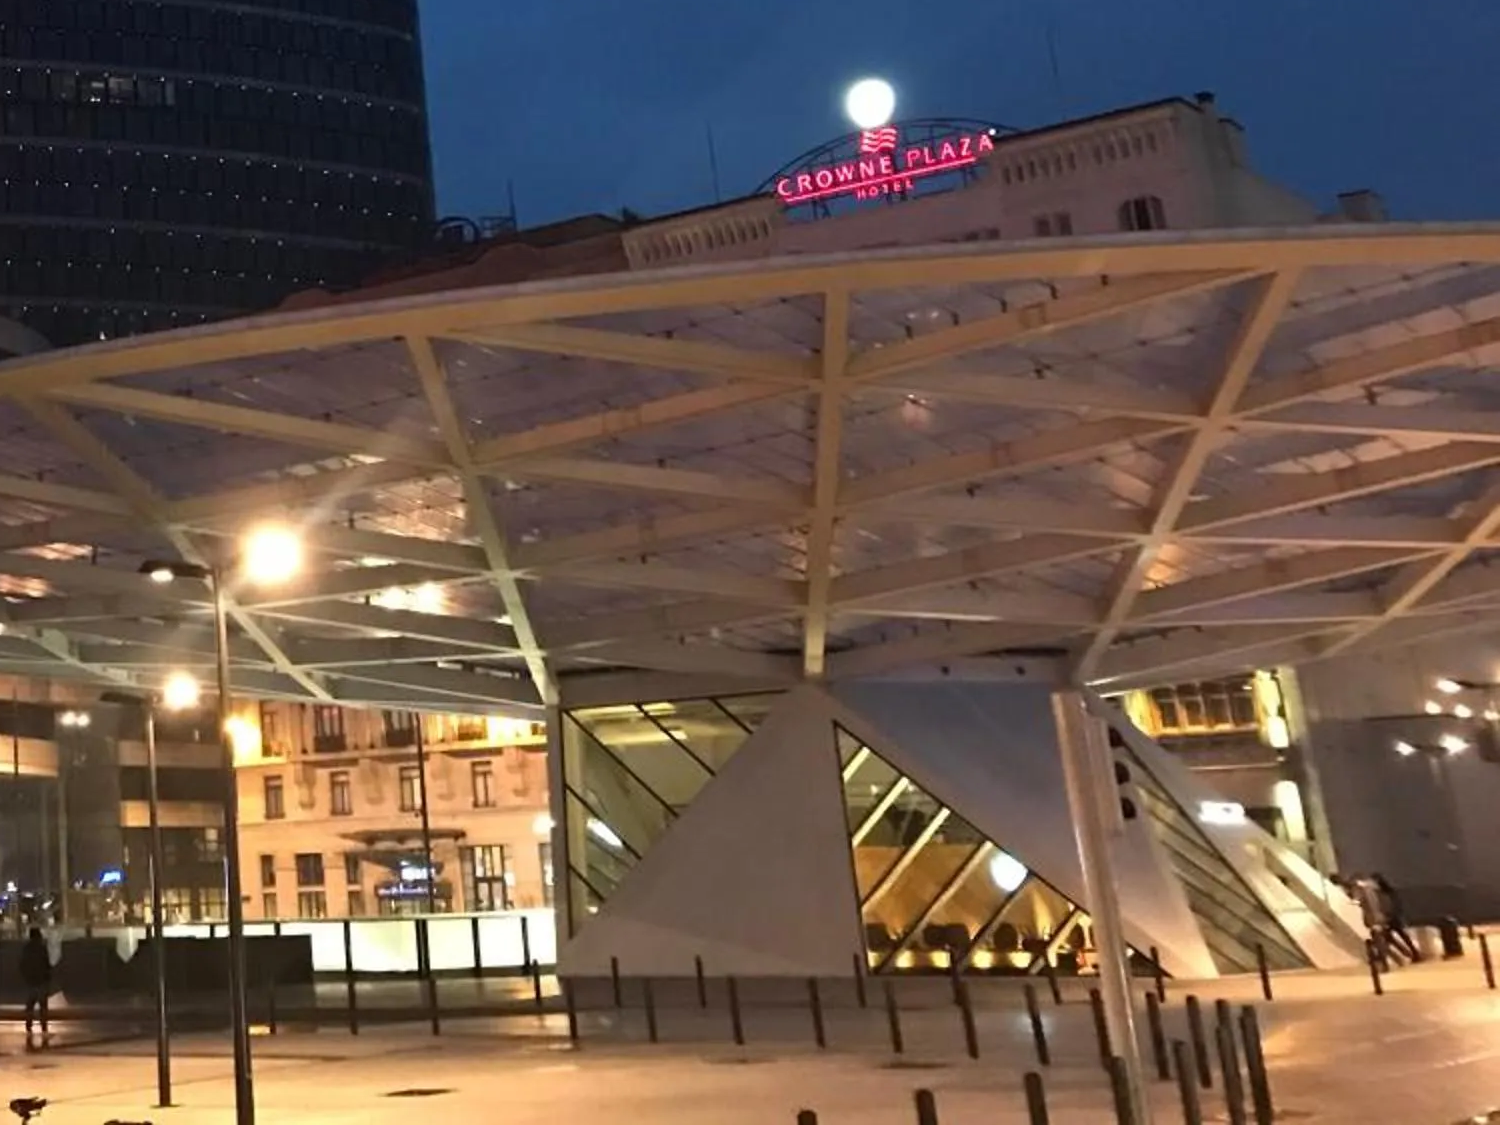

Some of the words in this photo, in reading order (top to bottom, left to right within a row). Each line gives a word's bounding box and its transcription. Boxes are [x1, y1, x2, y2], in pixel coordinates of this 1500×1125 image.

[777, 155, 893, 197] CROWNE
[906, 134, 994, 167] PLAZA
[856, 177, 914, 200] HOTEL
